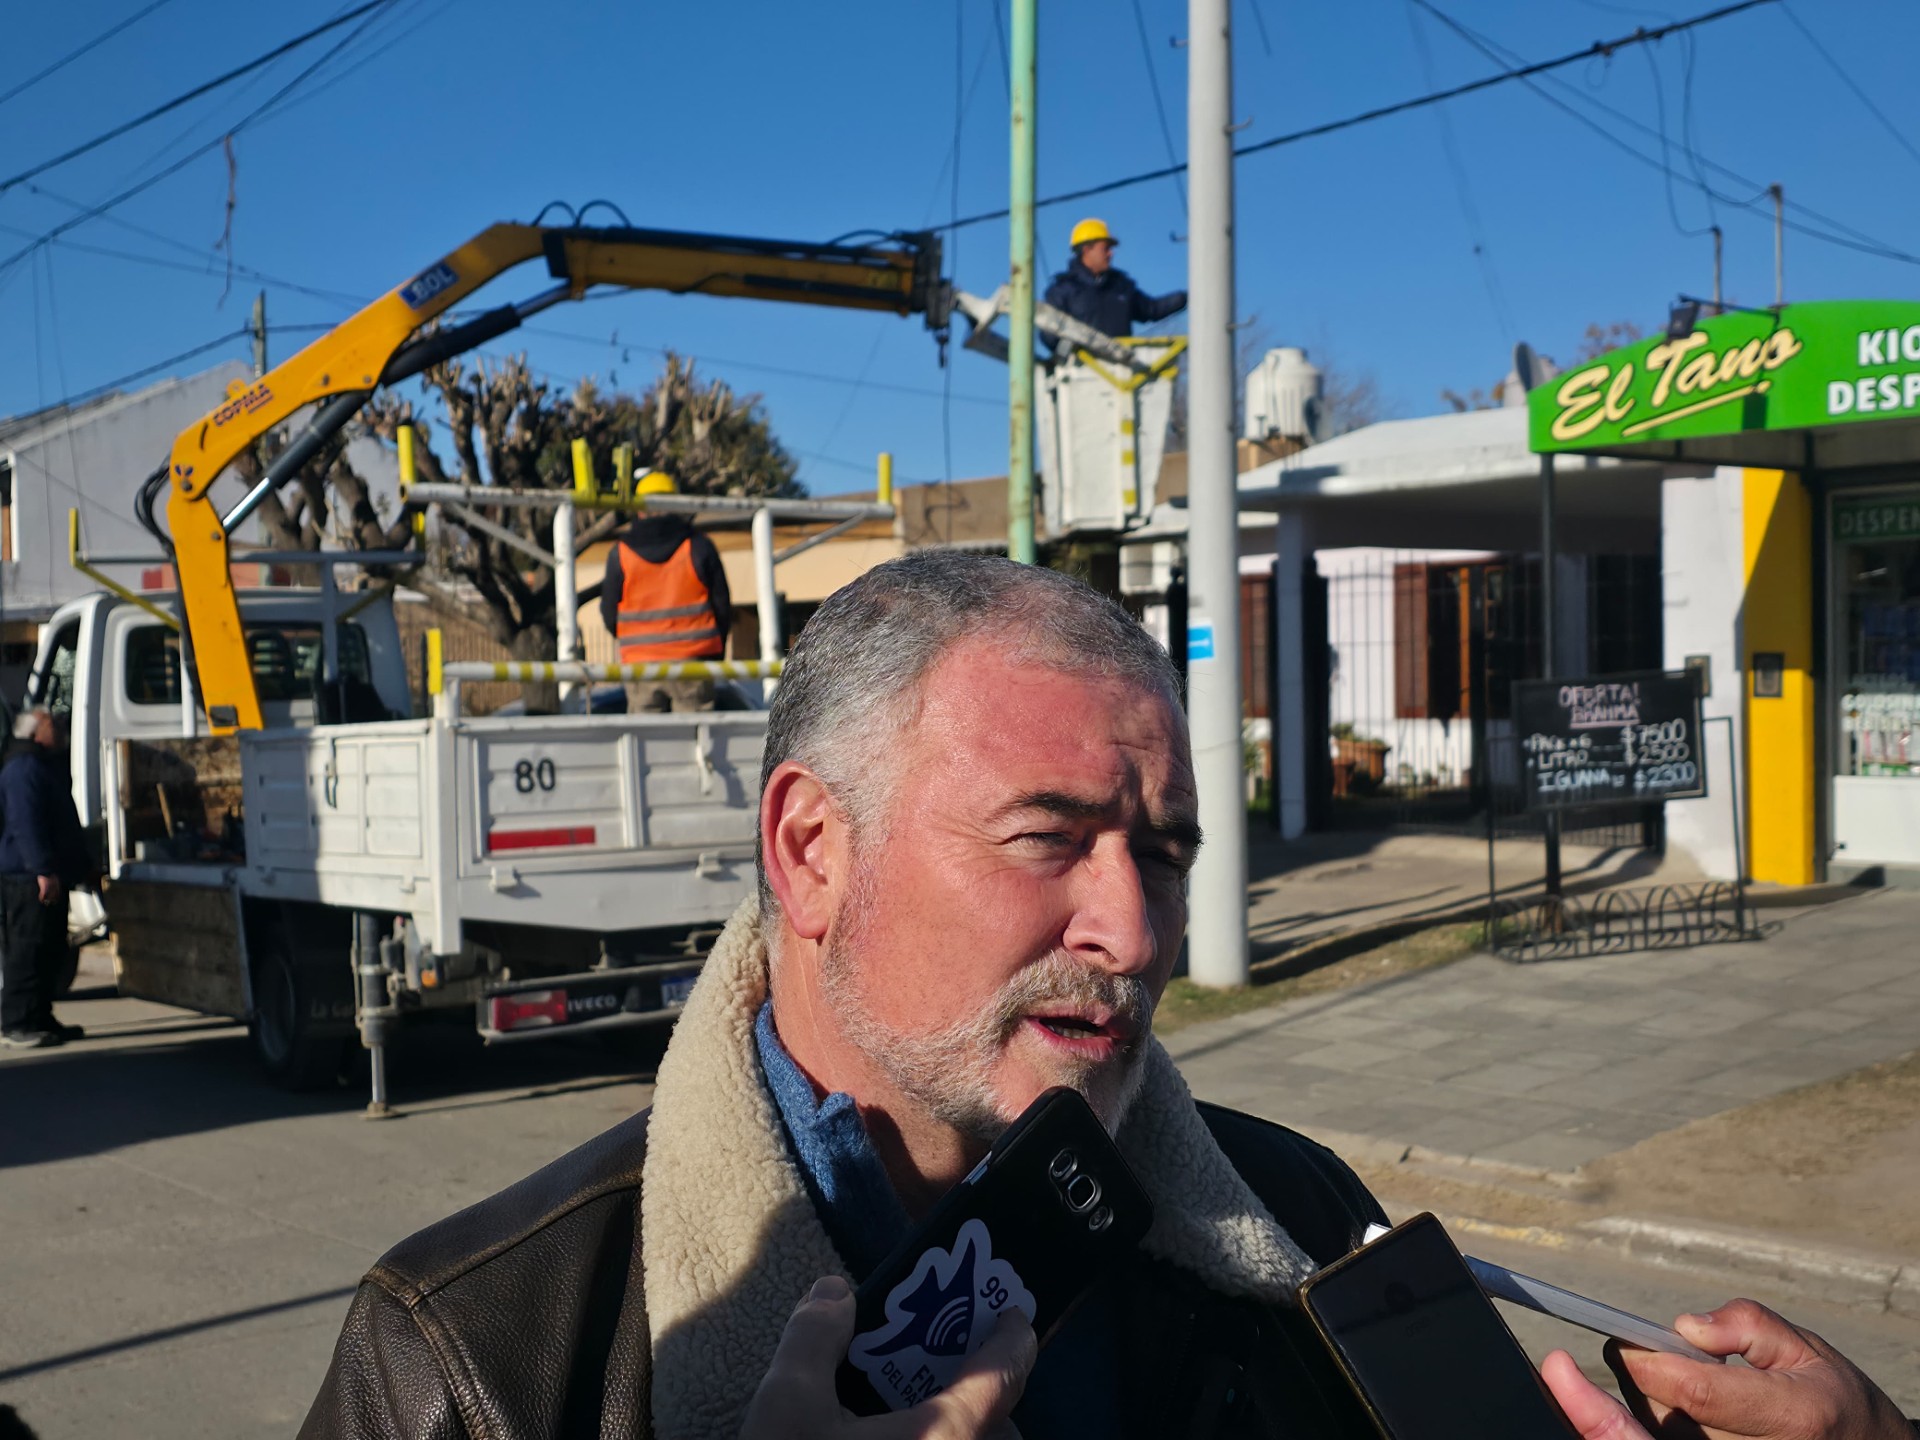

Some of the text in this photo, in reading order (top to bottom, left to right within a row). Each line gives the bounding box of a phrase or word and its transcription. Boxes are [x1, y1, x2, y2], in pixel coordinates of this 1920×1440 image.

[1857, 326, 1920, 366] KIO
[1551, 327, 1802, 441] El Tano
[1827, 374, 1920, 415] DESP
[514, 757, 556, 793] 80
[568, 994, 617, 1013] IVECO
[881, 1359, 899, 1390] DEL
